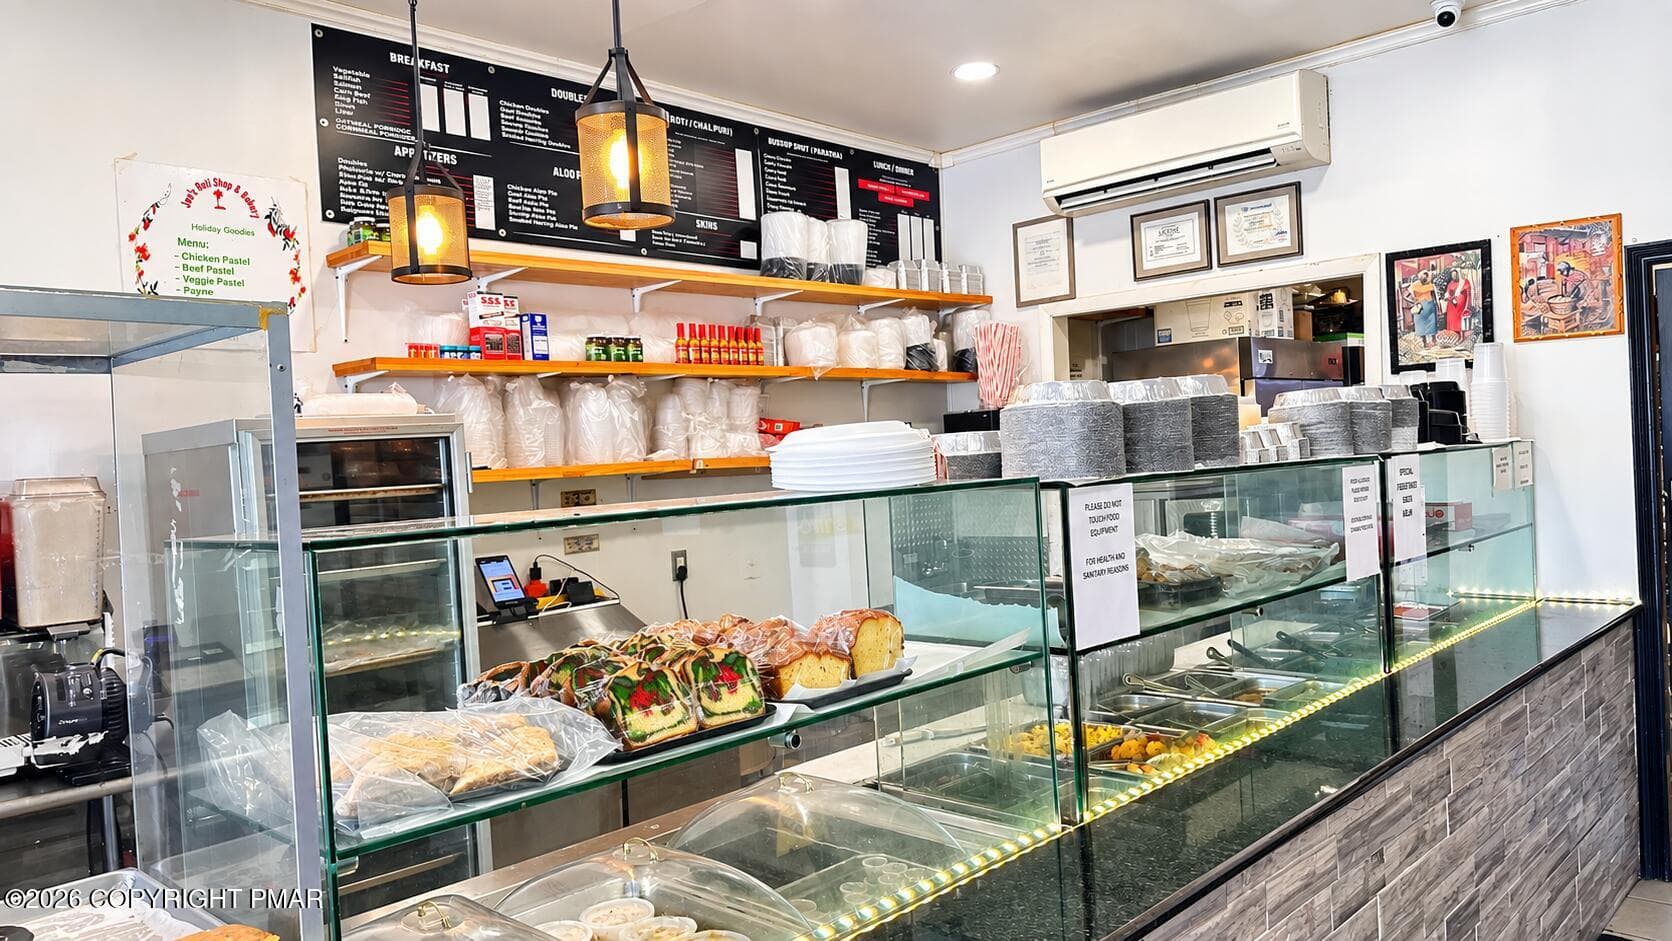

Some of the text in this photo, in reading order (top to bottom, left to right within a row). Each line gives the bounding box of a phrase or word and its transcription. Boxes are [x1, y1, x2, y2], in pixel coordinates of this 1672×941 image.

[394, 145, 457, 165] APPTIZERS
[213, 178, 232, 191] Shop
[192, 223, 255, 236] Holiday Goodies
[177, 237, 209, 249] Menu:
[182, 252, 220, 263] Chicken
[222, 256, 250, 265] Pastel
[182, 264, 204, 272] Beef
[206, 265, 234, 275] Pastel
[183, 275, 214, 286] Veggie
[217, 278, 245, 287] Pastel
[184, 286, 214, 296] Payne
[1085, 502, 1103, 511] PLEASE
[1104, 501, 1111, 509] DO
[1089, 513, 1120, 525] TOUCH FOOD
[1090, 526, 1118, 537] EQUIPMENT
[1086, 557, 1096, 566] FOR
[1097, 554, 1115, 564] HEALTH
[1083, 564, 1129, 580] SANITARY REASONS
